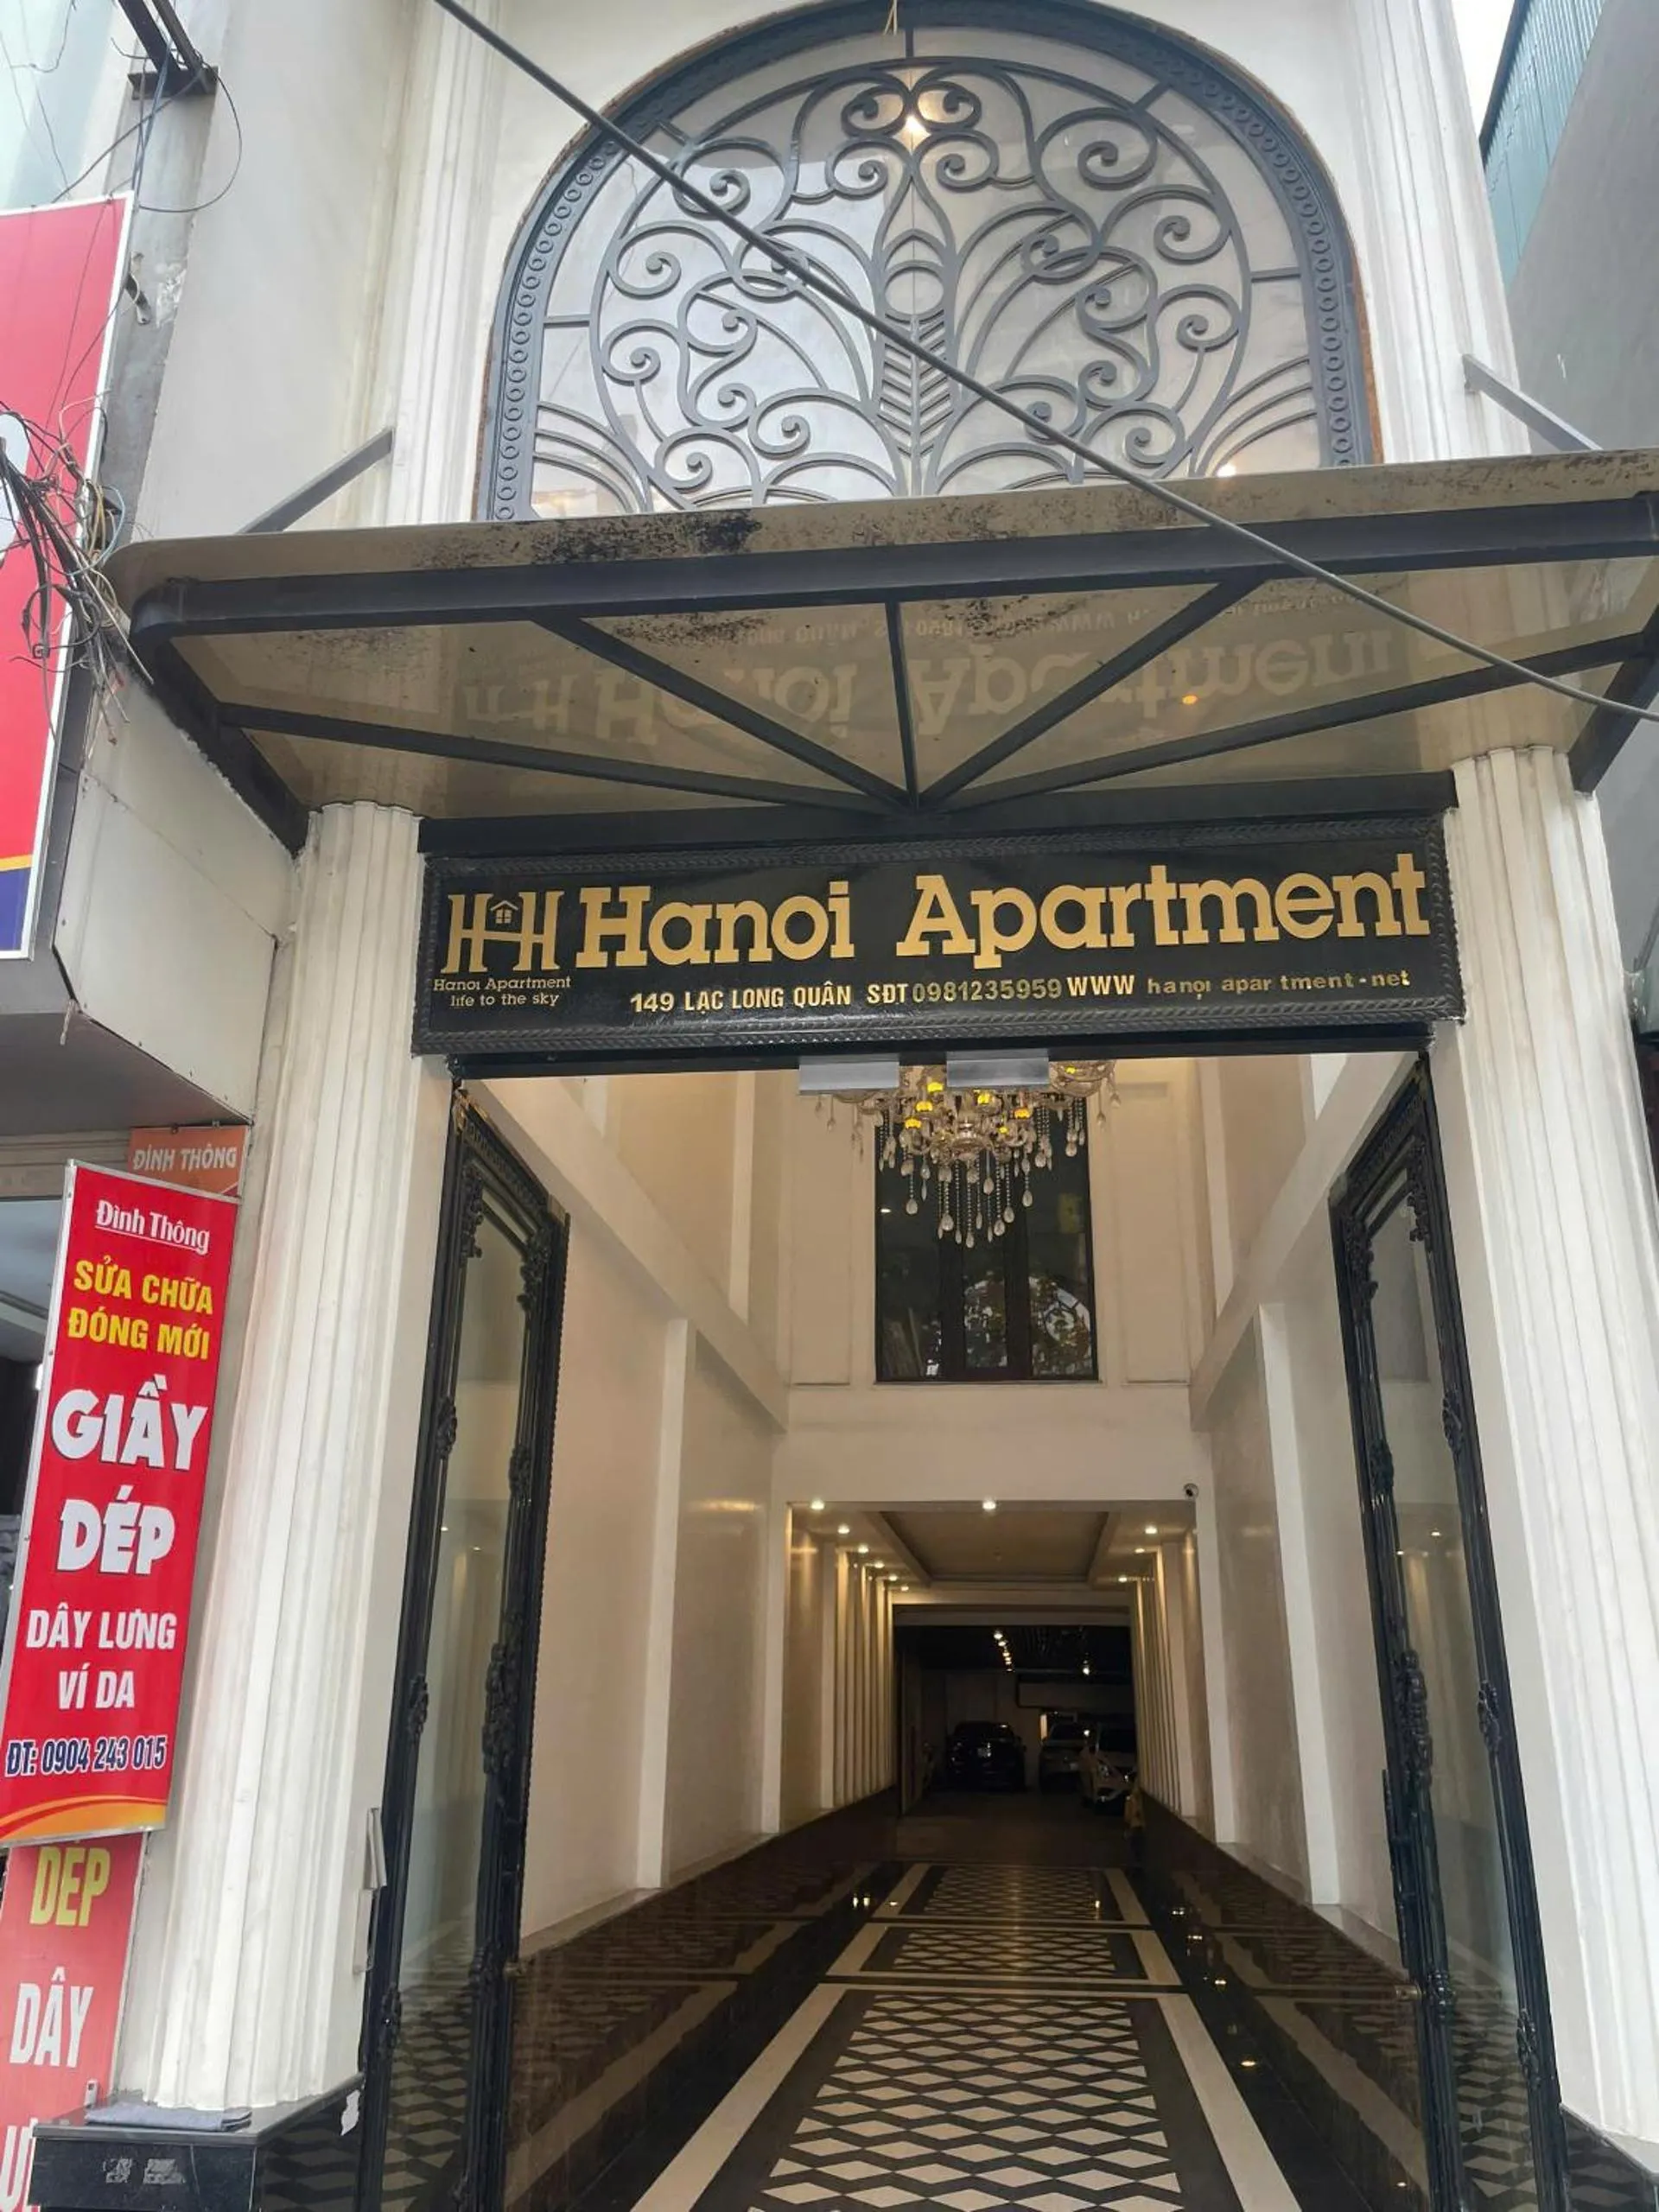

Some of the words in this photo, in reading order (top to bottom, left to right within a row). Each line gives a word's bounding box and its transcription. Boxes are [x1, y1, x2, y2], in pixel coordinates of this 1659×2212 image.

[575, 880, 855, 969] Hanoi
[896, 853, 1431, 969] Apartment
[433, 978, 480, 992] Hanoi
[485, 976, 571, 993] Apartment
[451, 995, 475, 1007] life
[480, 995, 495, 1007] to
[501, 993, 527, 1006] the
[532, 993, 560, 1007] sky
[630, 992, 675, 1013] 149
[683, 990, 723, 1014] LẠC
[732, 988, 784, 1009] LONG
[793, 981, 851, 1007] QUÂN
[868, 982, 908, 1005] SĐT
[912, 978, 1062, 1003] 0981235959
[1067, 975, 1135, 997] WWW
[96, 1199, 145, 1236] Đình
[150, 1211, 210, 1255] Thông
[73, 1255, 132, 1300] SỬA
[142, 1274, 213, 1315] CHỮA
[67, 1306, 148, 1351] ĐÓNG
[157, 1322, 211, 1360] MỚI
[50, 1374, 208, 1471] GIẦY
[57, 1484, 175, 1574] DÉP
[26, 1602, 92, 1649] DÂY
[98, 1610, 177, 1649] LƯNG
[58, 1662, 91, 1710] VÍ
[95, 1670, 135, 1709] DA
[5, 1740, 37, 1777] ĐT:
[41, 1736, 90, 1774] 0904
[92, 1736, 127, 1772] 243
[132, 1734, 168, 1770] 015
[9, 1966, 93, 2068] DÂY
